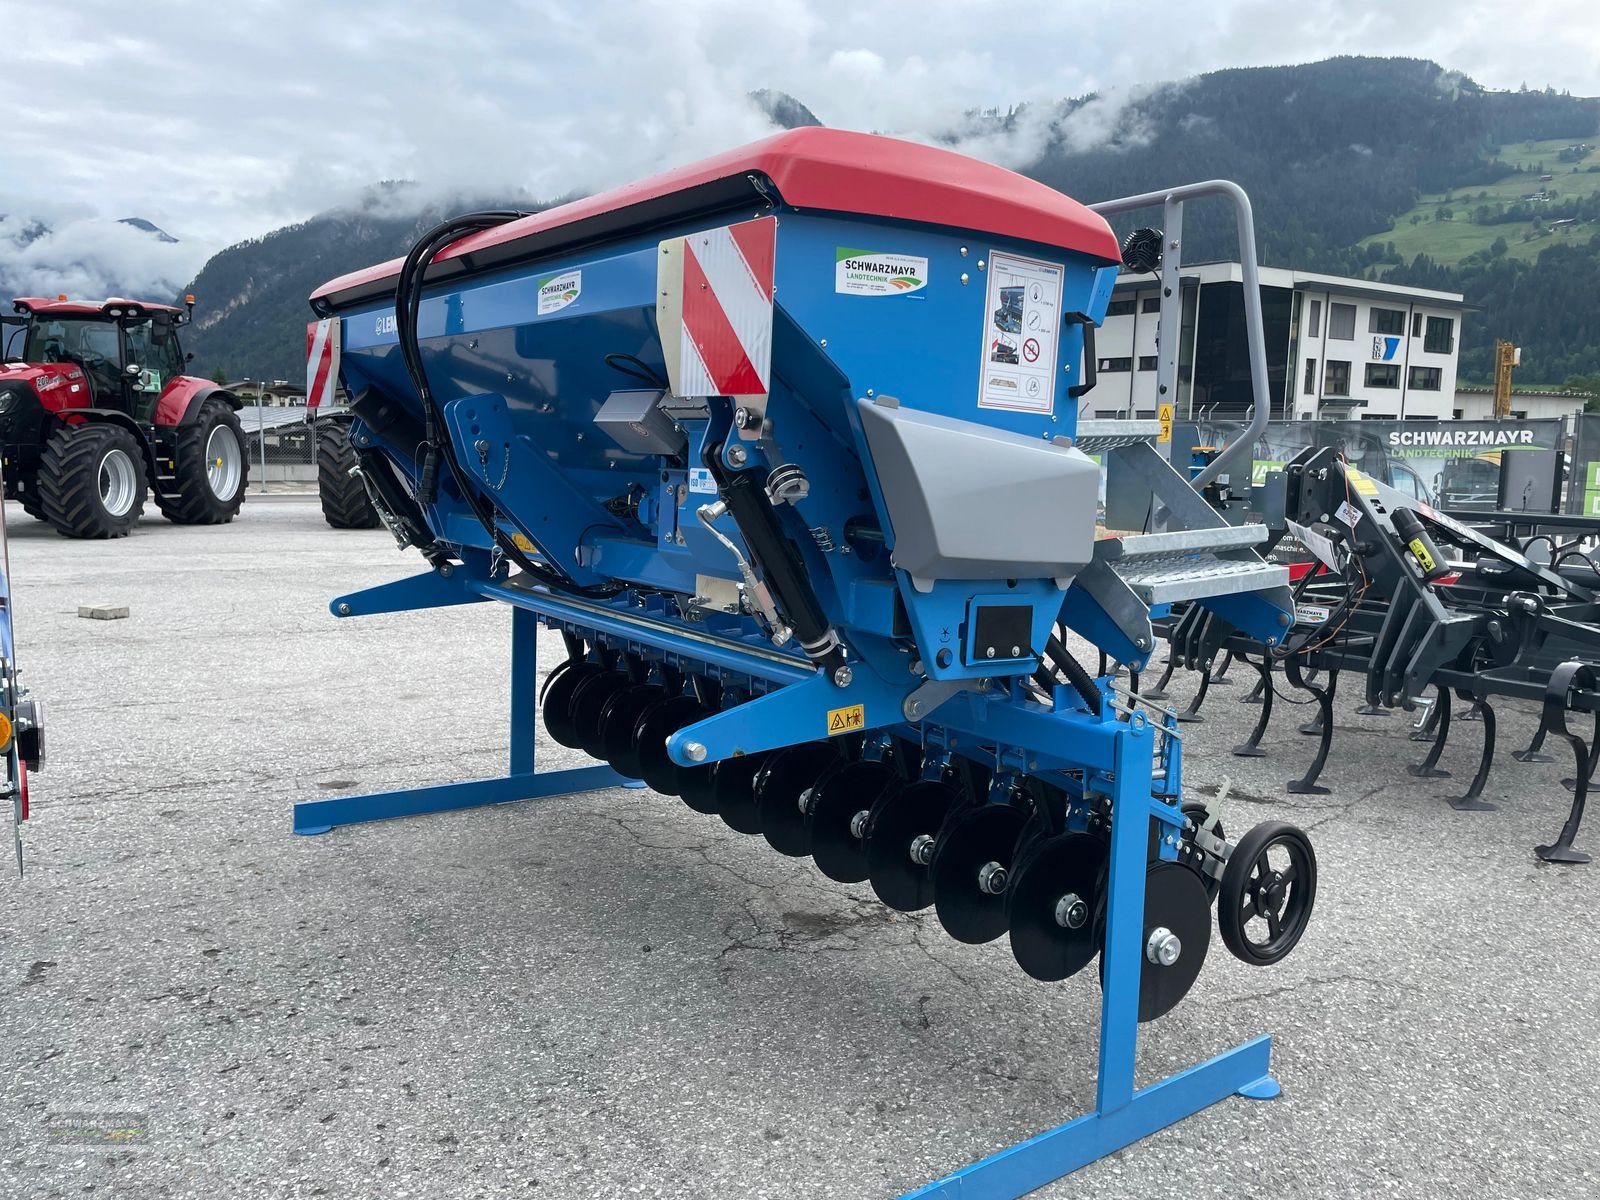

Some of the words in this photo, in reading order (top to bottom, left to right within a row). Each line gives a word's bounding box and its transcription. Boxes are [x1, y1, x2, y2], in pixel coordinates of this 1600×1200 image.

[844, 260, 916, 276] SCHWARZMAYR
[846, 272, 888, 282] LANDTECHNIK
[1389, 430, 1534, 446] SCHWARZMAYR
[1391, 449, 1473, 459] LANDTECHNIK
